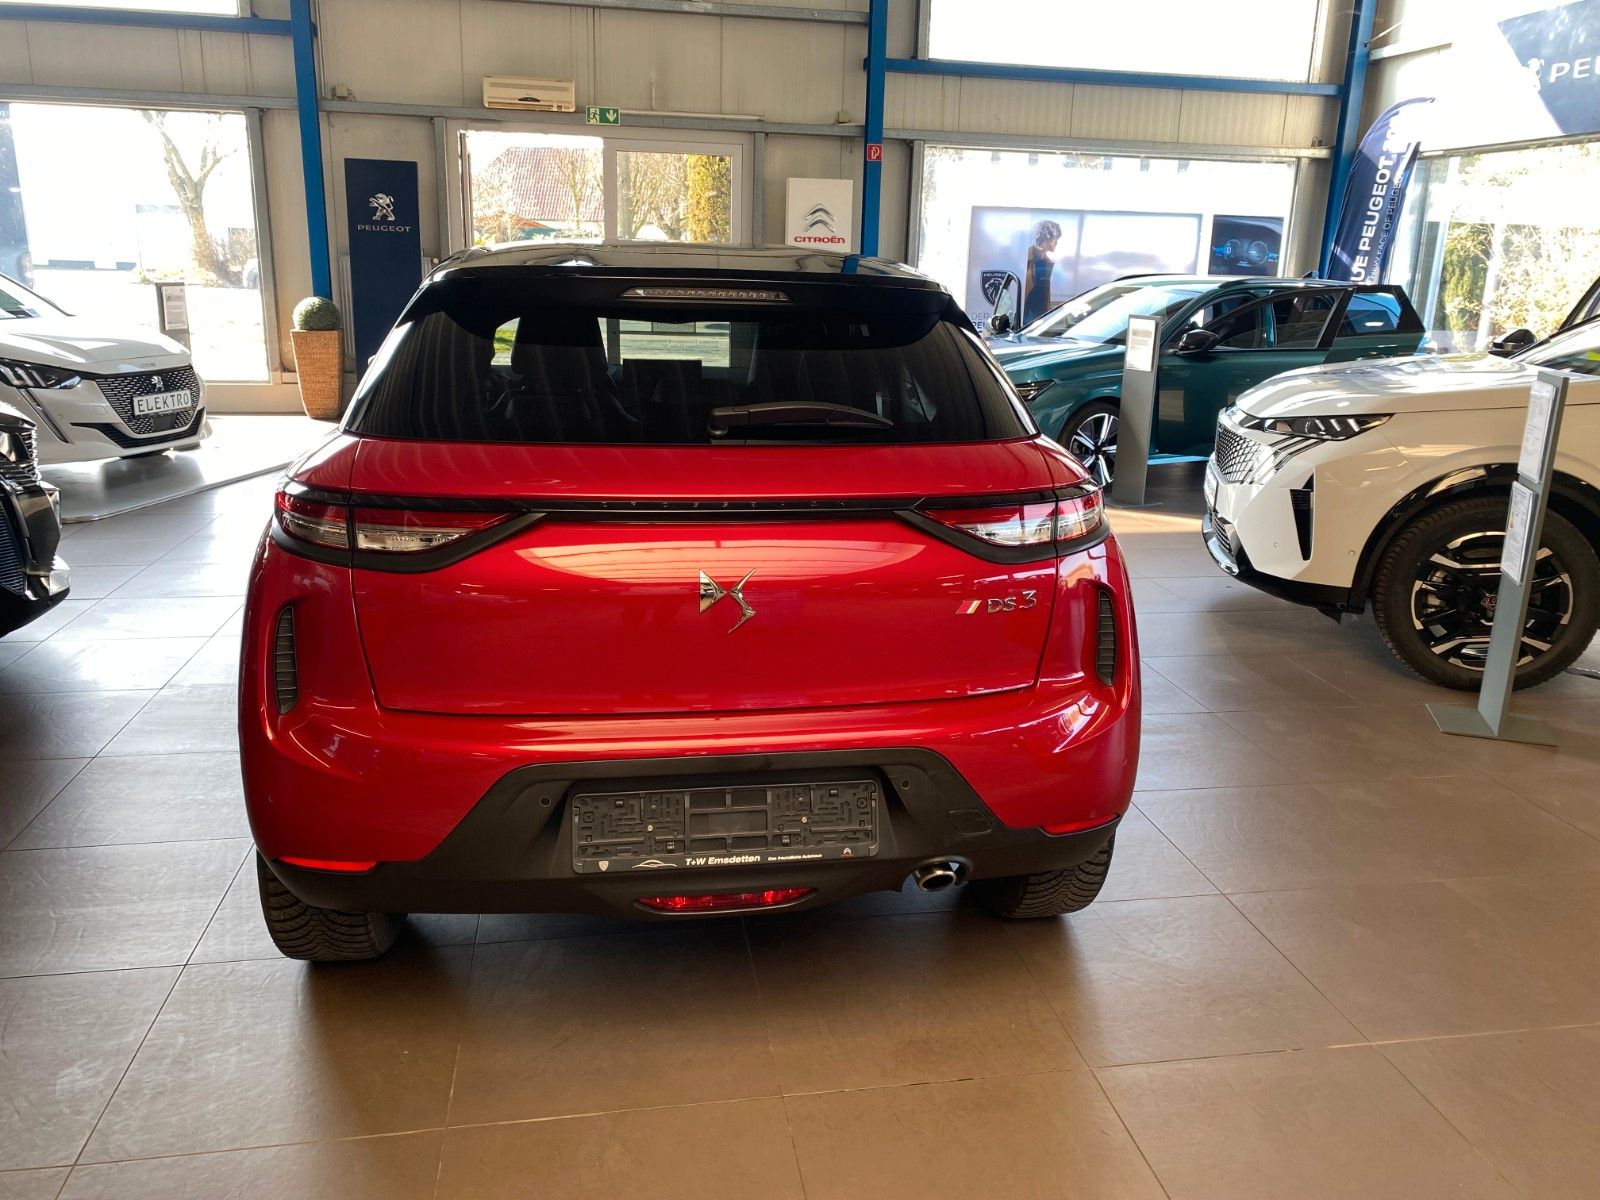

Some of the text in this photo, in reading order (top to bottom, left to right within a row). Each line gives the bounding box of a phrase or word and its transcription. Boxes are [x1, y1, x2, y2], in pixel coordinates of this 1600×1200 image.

[357, 224, 411, 232] PEUGEOT
[1350, 255, 1369, 282] UE
[137, 392, 190, 413] ELEKTRO
[987, 590, 1037, 613] DS 3
[685, 857, 706, 867] T+W
[707, 854, 761, 866] Emsdetten
